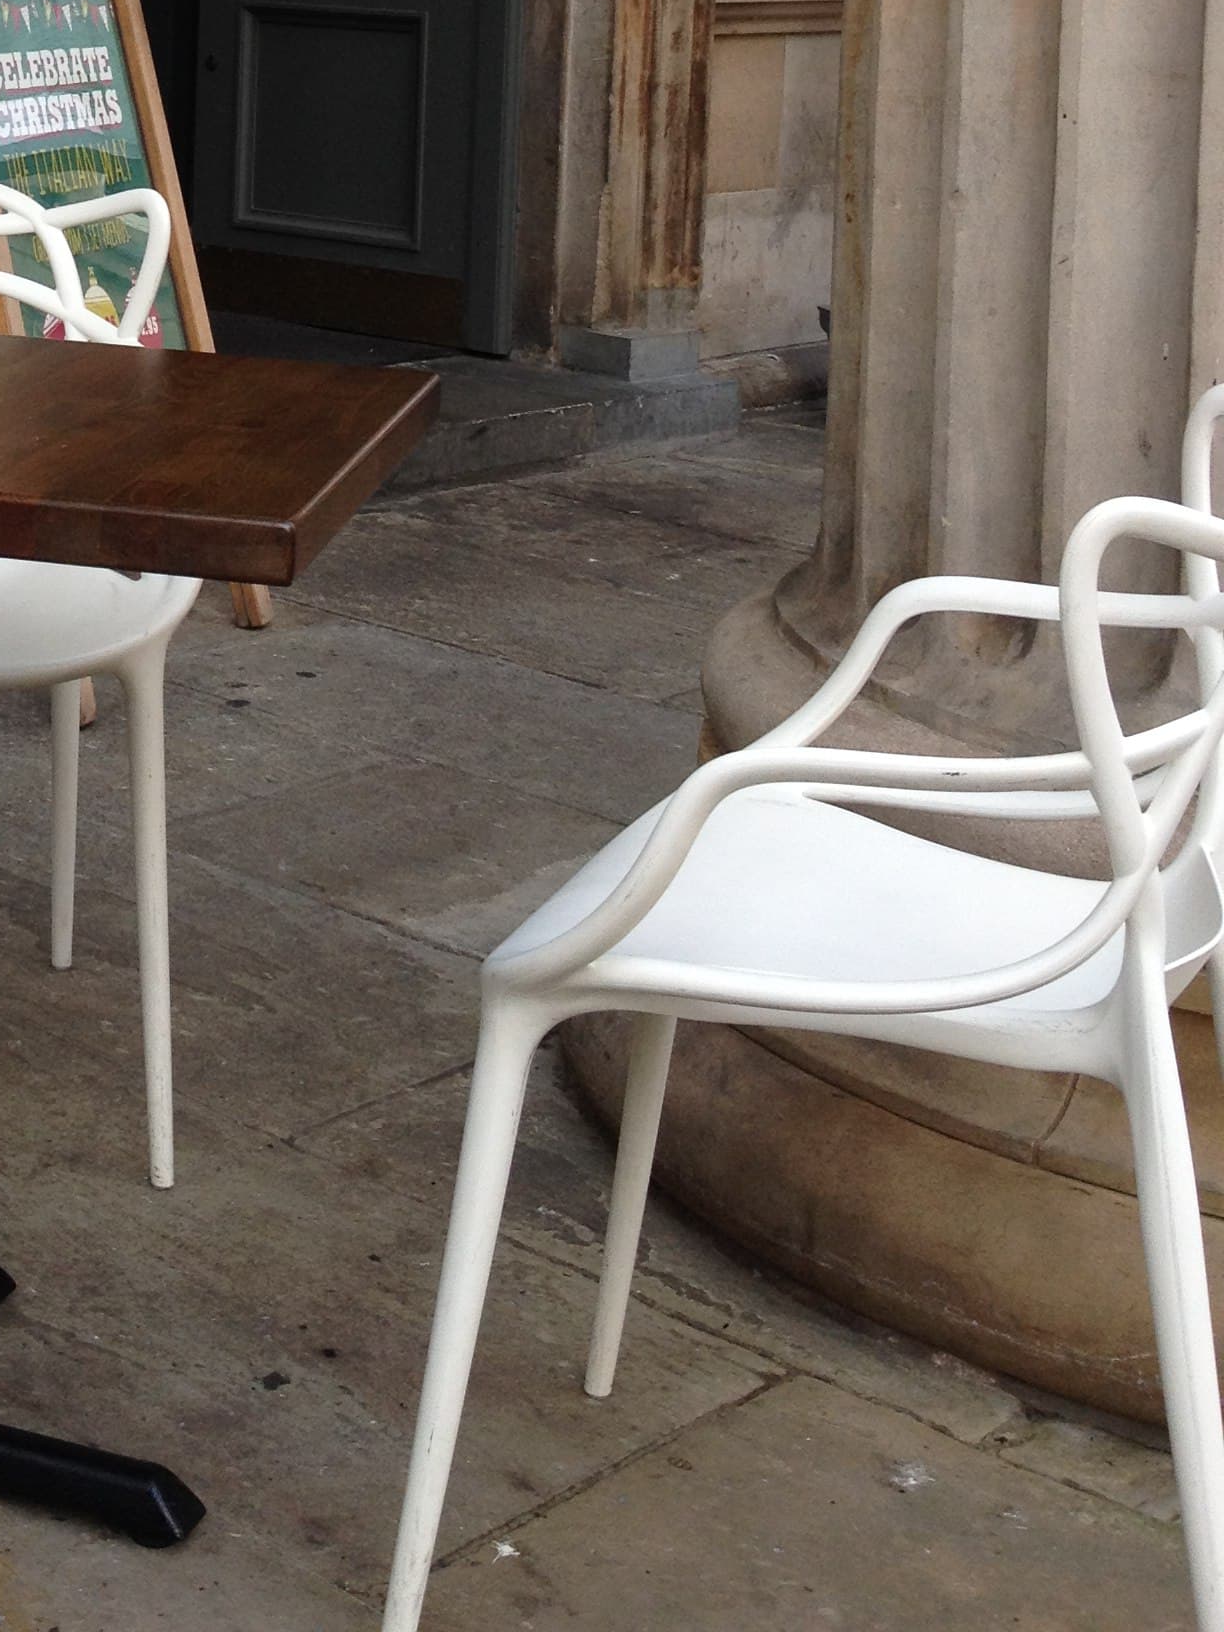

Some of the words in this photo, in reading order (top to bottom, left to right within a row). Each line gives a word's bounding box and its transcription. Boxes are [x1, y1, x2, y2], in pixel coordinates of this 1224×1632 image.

[3, 153, 34, 196] THE
[32, 144, 99, 195] ITALIAN
[98, 138, 132, 185] WAY
